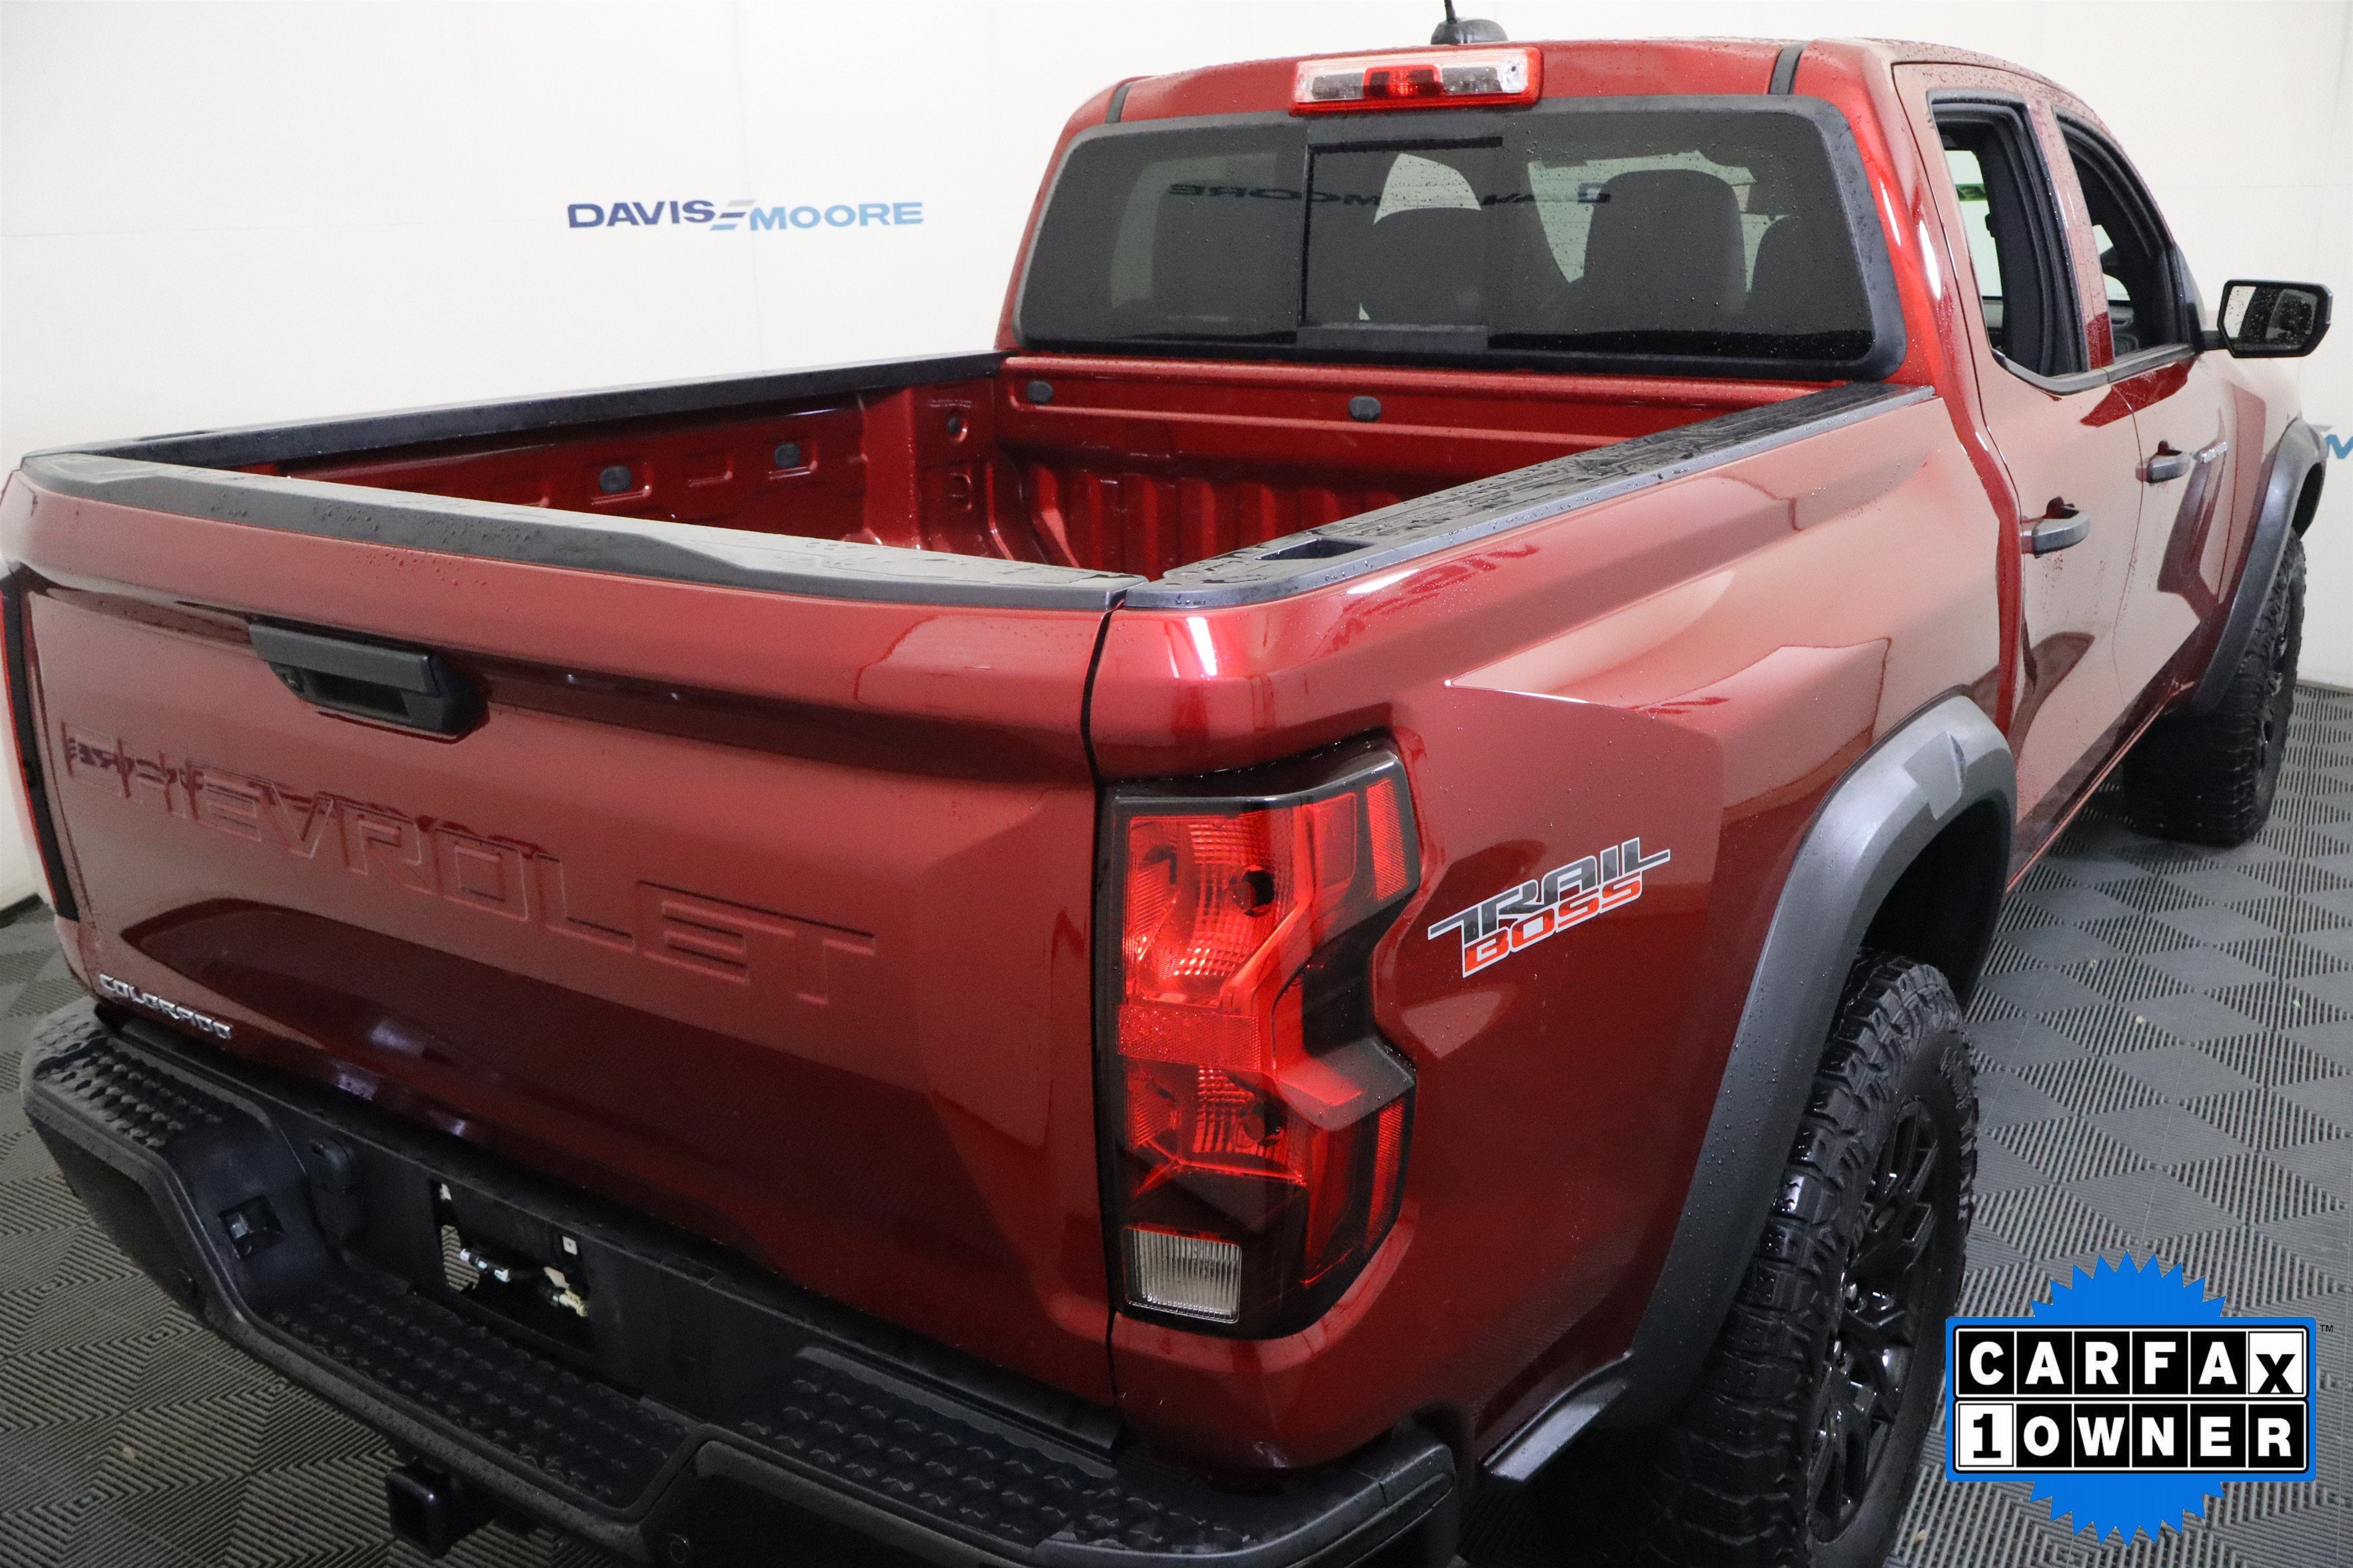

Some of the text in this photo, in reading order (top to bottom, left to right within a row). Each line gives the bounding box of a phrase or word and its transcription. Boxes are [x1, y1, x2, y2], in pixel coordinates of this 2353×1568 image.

[568, 200, 924, 231] DAVIS MOORE
[61, 721, 875, 1004] CHEVROLET
[1428, 837, 1671, 945] TRAIL
[1462, 875, 1643, 978] BOSS
[99, 974, 233, 1040] COLORADO
